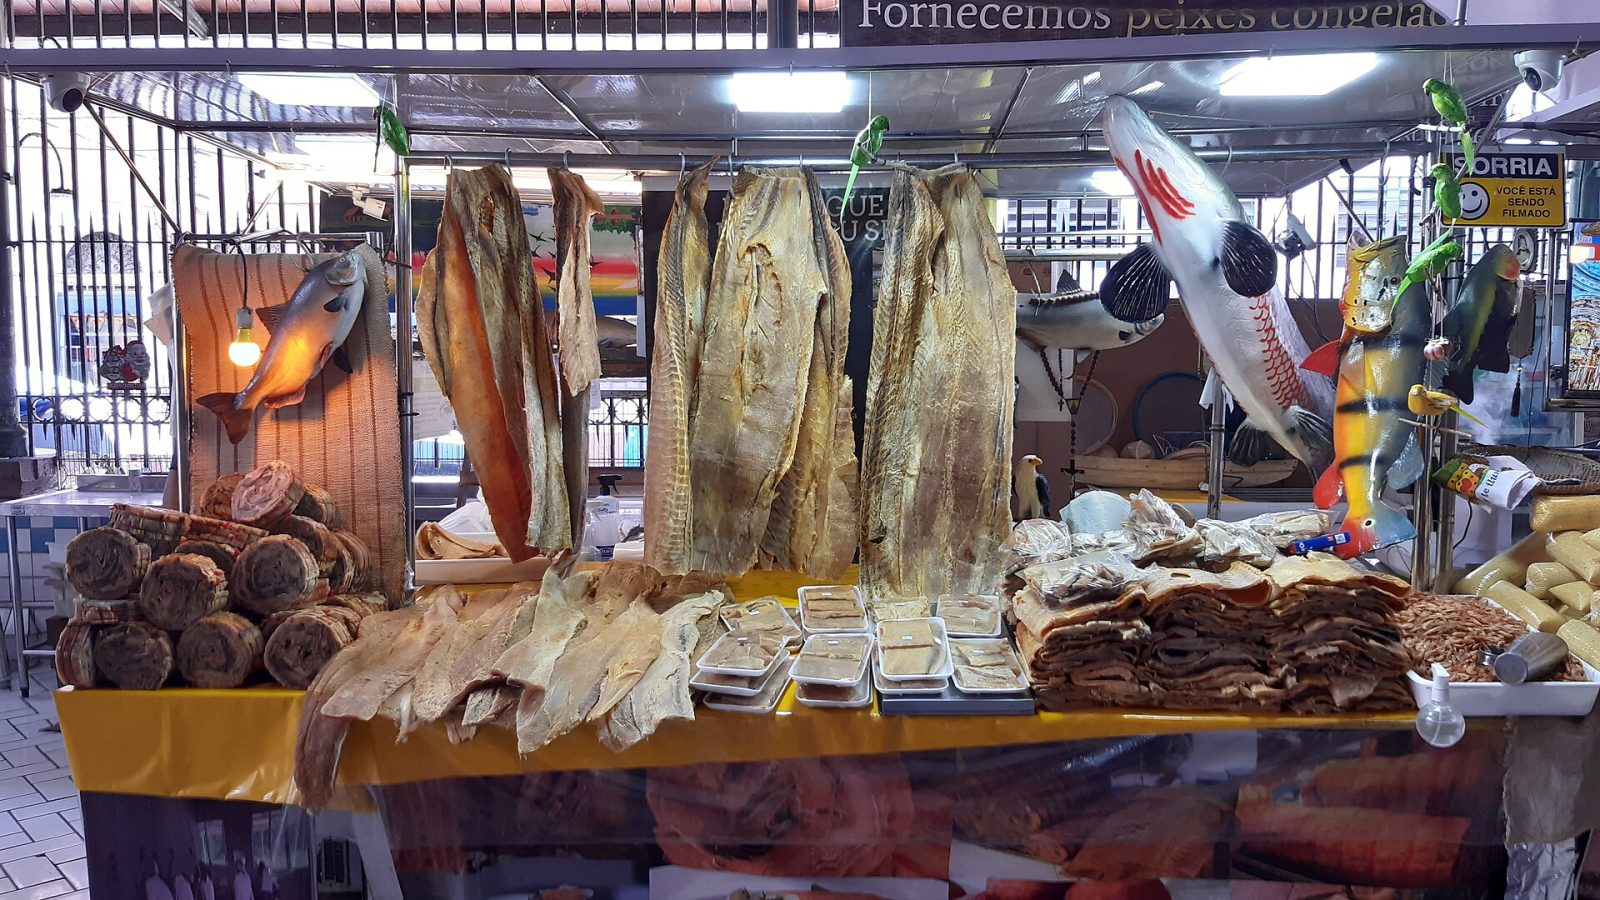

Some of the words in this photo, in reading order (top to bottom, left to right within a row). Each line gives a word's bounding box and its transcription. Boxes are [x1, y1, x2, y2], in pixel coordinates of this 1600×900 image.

[858, 0, 1111, 30] Fornecemos
[1127, 0, 1257, 38] peixes
[1454, 157, 1553, 176] SORRIA
[1496, 185, 1526, 196] VOCÊ
[1528, 186, 1557, 196] ESTÁ
[1508, 198, 1545, 207] SENDO
[1502, 209, 1551, 218] FILMADO
